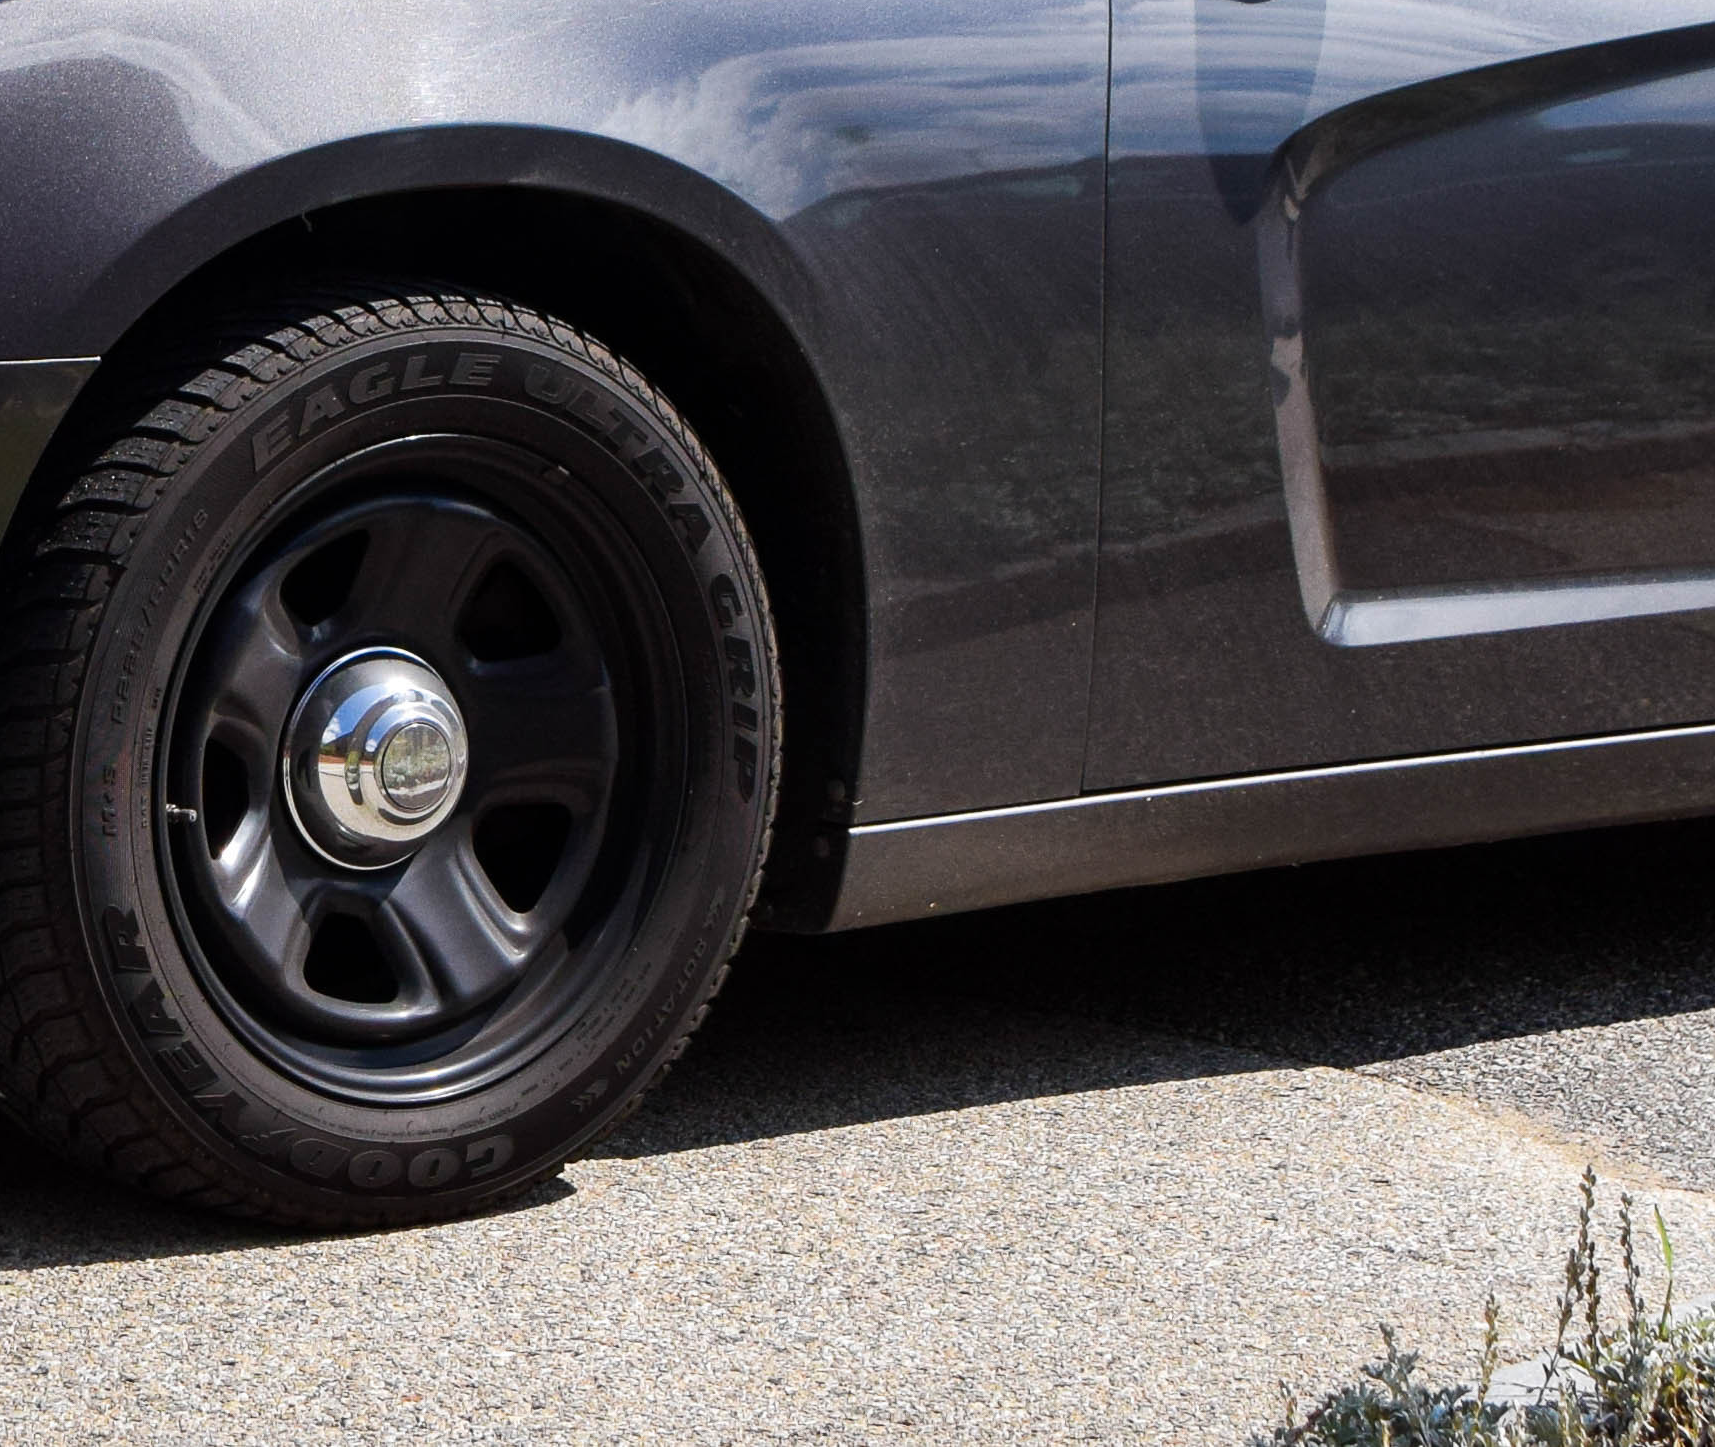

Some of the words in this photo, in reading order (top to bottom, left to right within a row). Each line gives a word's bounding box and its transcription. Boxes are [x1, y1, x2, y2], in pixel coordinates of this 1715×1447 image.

[248, 350, 504, 473] EAGLE
[523, 361, 713, 554] ULTRA
[710, 573, 759, 805] GRIP
